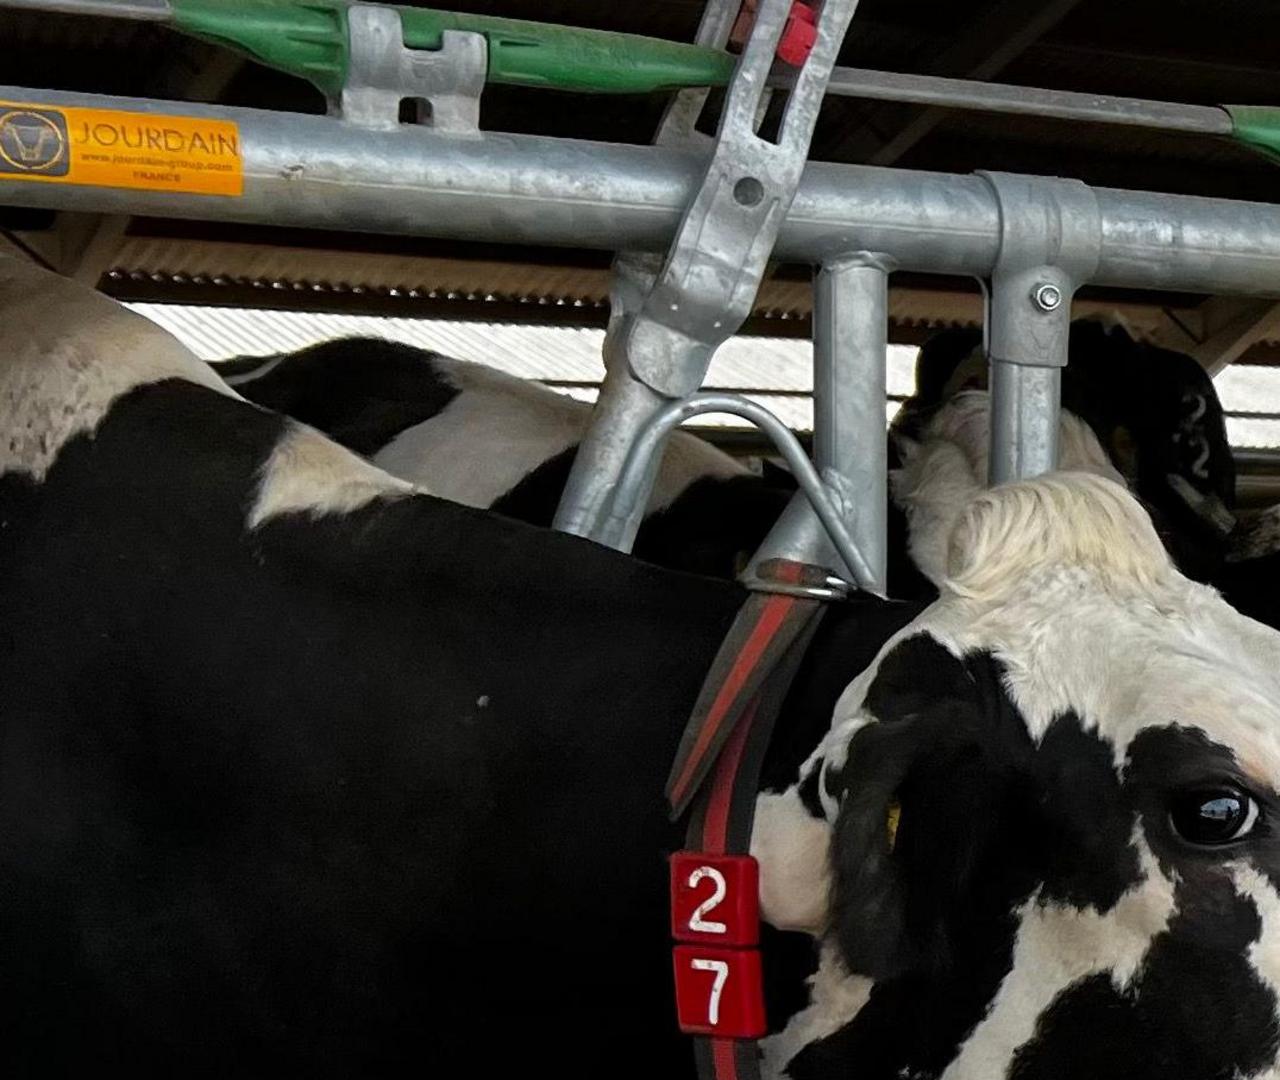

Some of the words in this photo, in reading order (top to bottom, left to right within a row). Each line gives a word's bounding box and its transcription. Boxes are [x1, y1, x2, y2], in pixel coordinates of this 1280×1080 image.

[75, 121, 239, 157] JOURDAIN
[132, 170, 181, 183] FRANCE
[688, 866, 727, 934] 2
[691, 958, 728, 1025] 7
